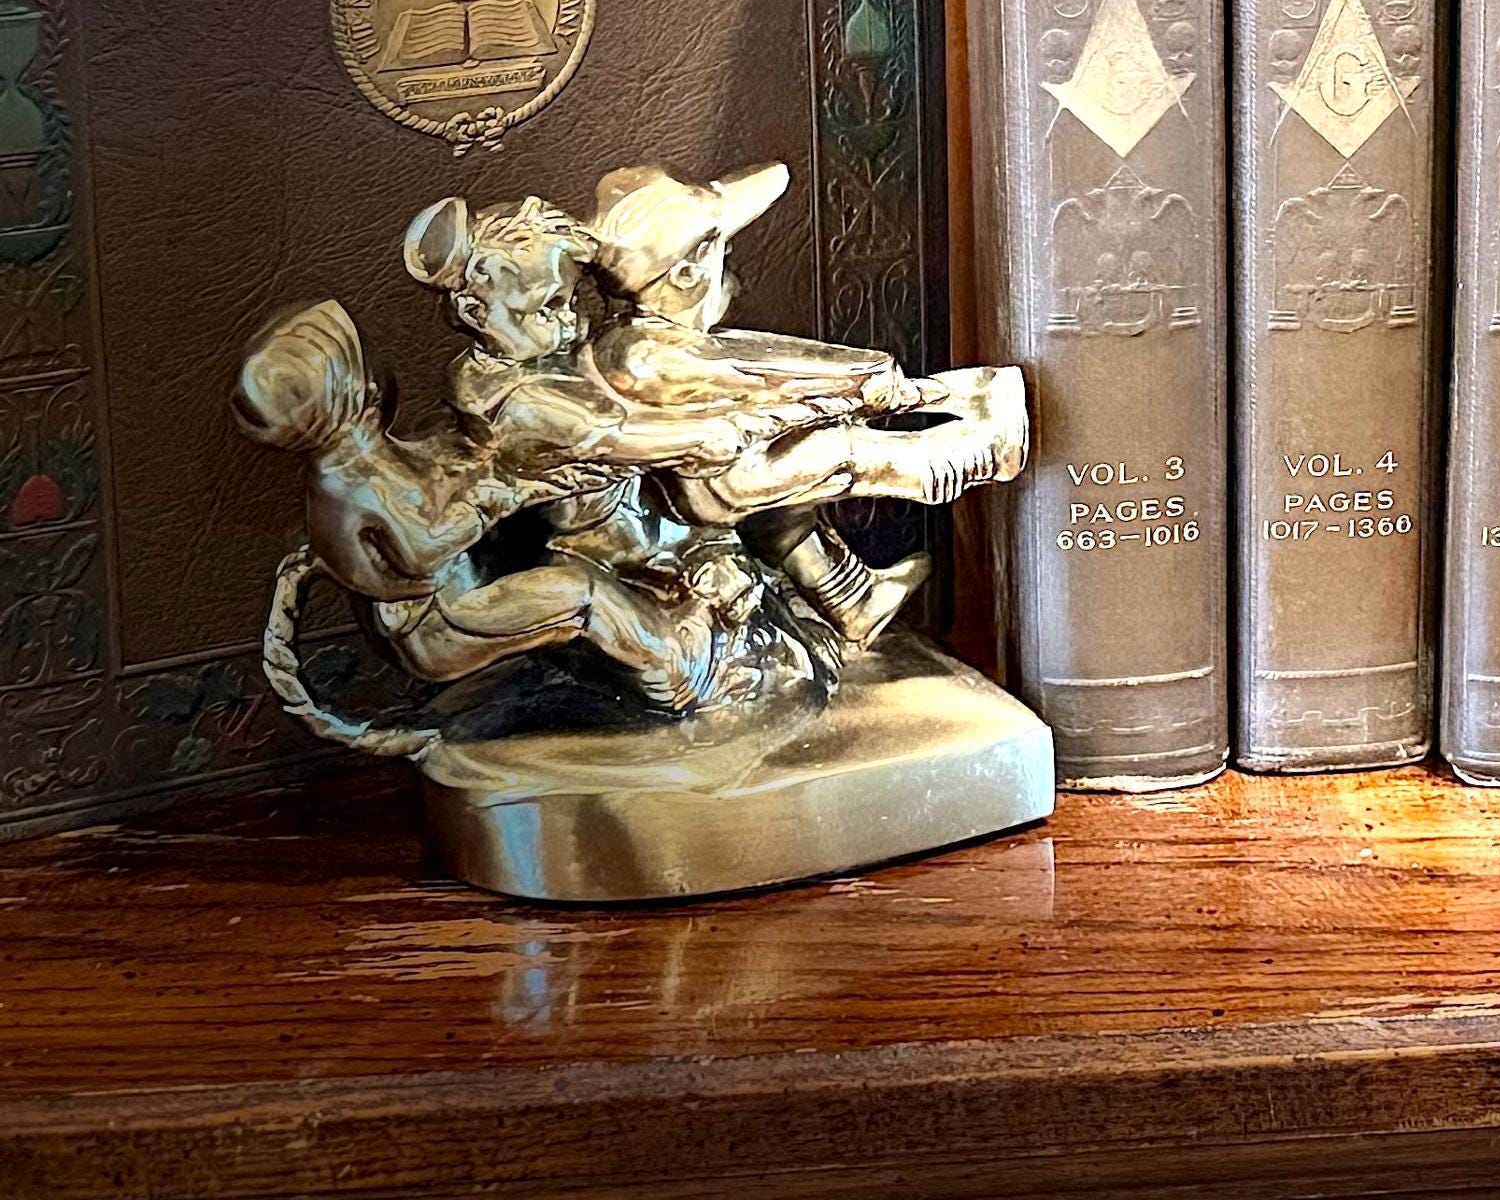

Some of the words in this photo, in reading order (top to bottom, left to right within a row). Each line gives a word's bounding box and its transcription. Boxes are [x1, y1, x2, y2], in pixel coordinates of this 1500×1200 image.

[1319, 50, 1373, 116] G
[1066, 462, 1149, 487] VOL.
[1164, 456, 1186, 481] 3
[1282, 453, 1363, 477] VOL.
[1375, 451, 1398, 474] 4
[1070, 496, 1185, 524] PAGES
[1284, 489, 1394, 513] PAGES
